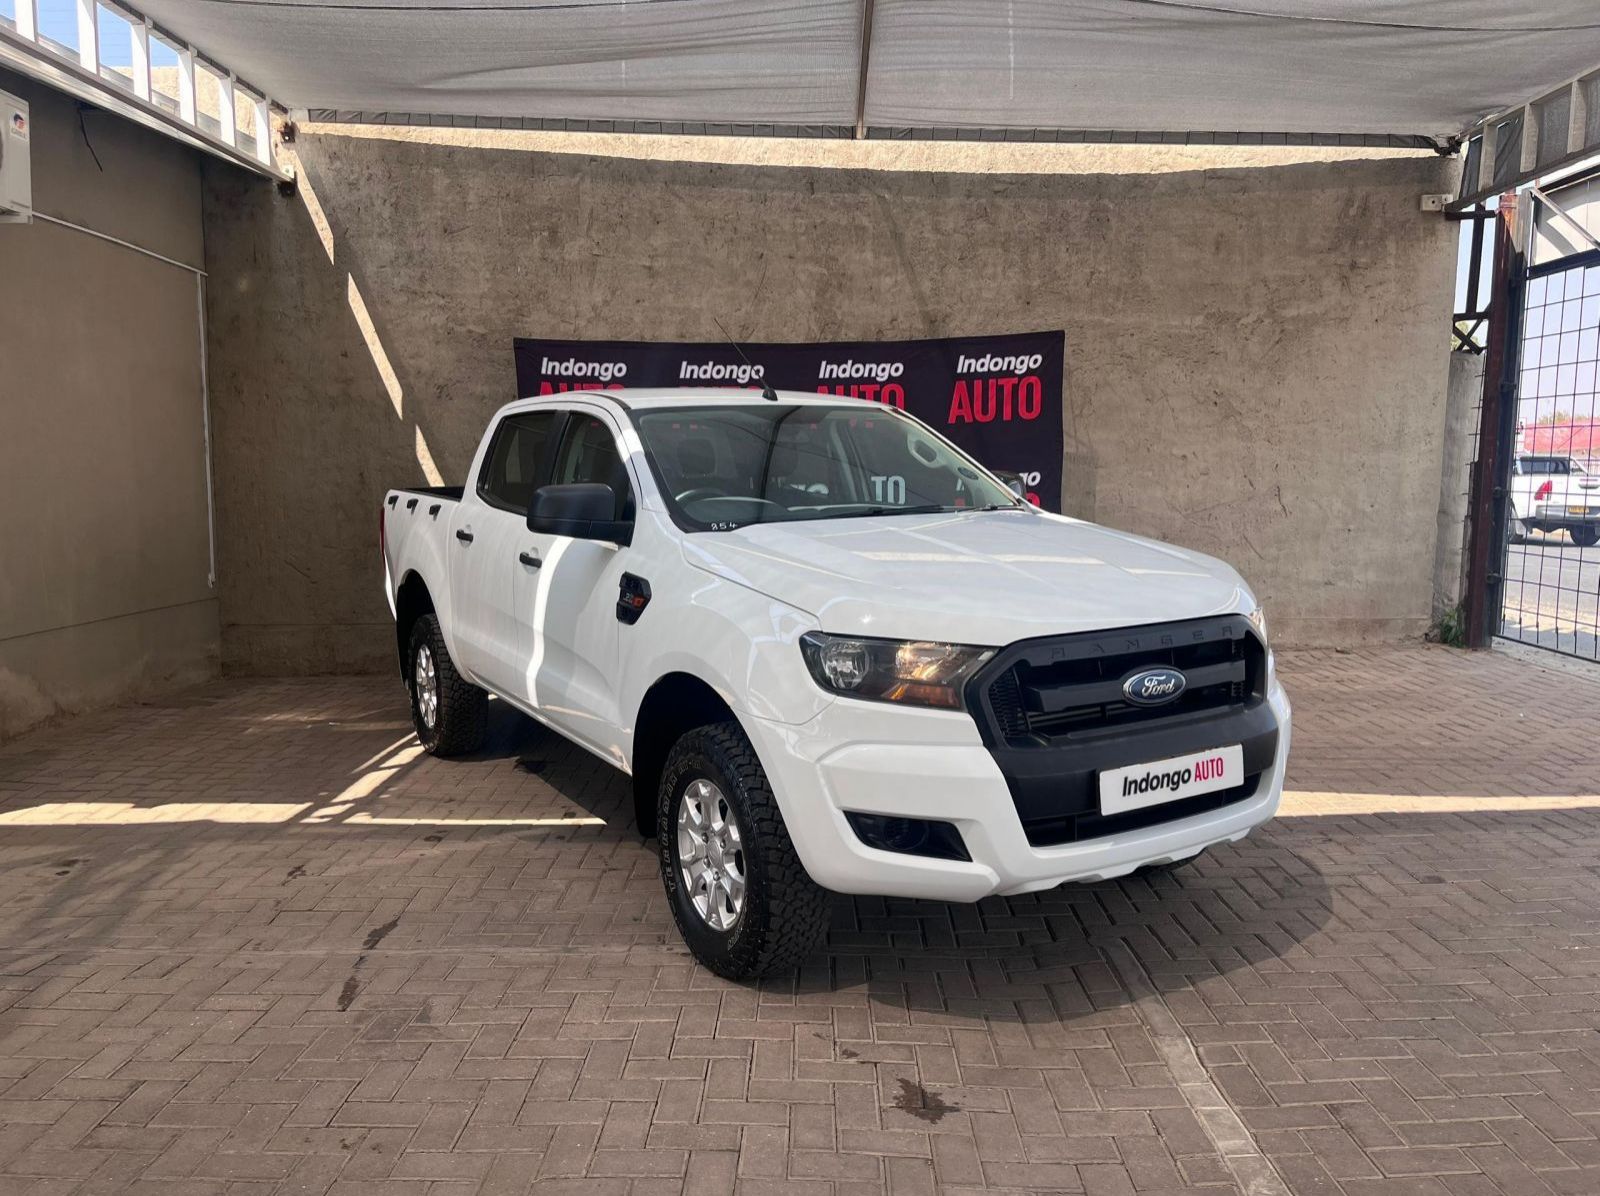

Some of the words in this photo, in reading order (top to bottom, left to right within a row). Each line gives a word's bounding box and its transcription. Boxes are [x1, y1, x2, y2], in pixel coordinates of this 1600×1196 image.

[541, 357, 627, 380] Indongo
[679, 361, 765, 384] Indongo
[818, 360, 904, 381] Indongo
[957, 353, 1043, 375] Indongo
[948, 376, 1042, 424] AUTO
[1051, 625, 1233, 659] RANGER
[1141, 675, 1175, 697] Ford
[1122, 768, 1192, 797] Indongo
[1194, 757, 1224, 782] AUTO
